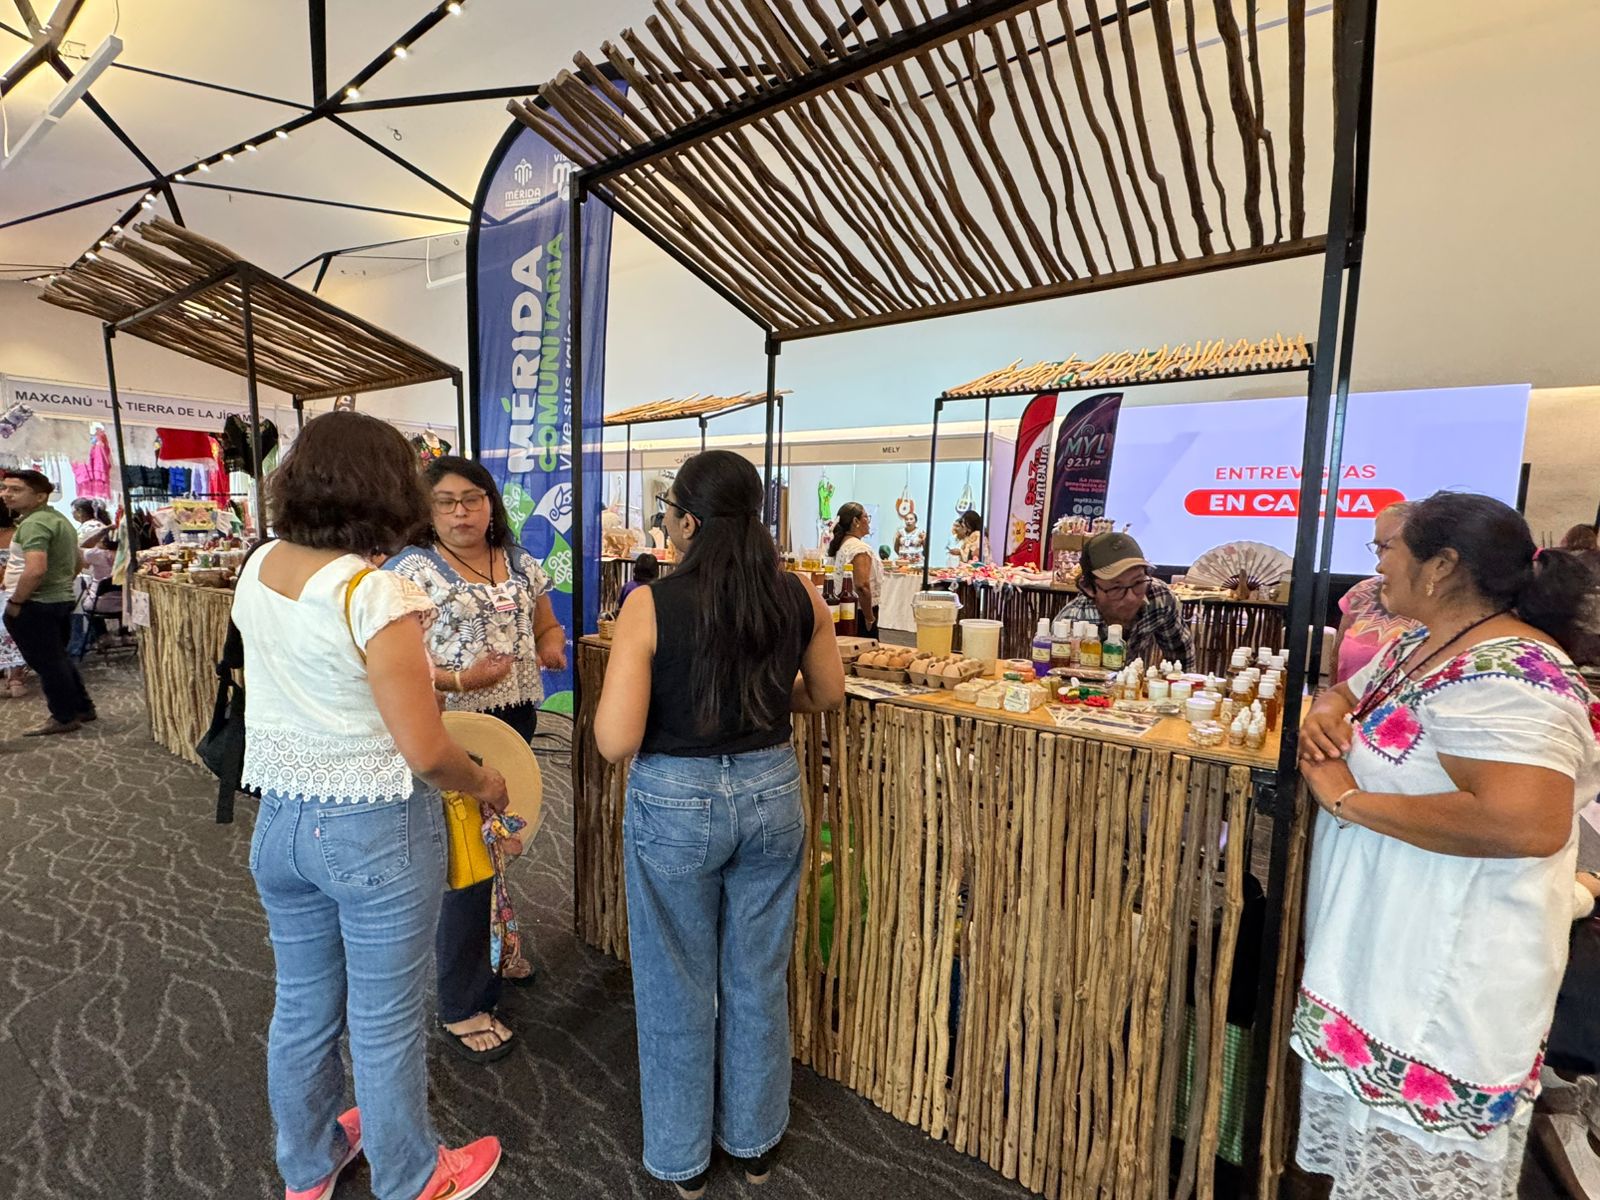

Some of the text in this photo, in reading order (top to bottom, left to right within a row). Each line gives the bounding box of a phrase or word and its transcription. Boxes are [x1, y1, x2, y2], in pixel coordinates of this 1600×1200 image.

[501, 245, 542, 474] MÉRIDA
[538, 232, 563, 473] COMUNITARIA
[15, 390, 92, 407] MAXCANÚ
[125, 401, 175, 415] TIERRA
[177, 406, 194, 417] DE
[198, 409, 214, 419] LA
[882, 446, 901, 454] MELY
[1215, 464, 1377, 480] ENTREVAS
[1208, 493, 1375, 513] EN CAINA
